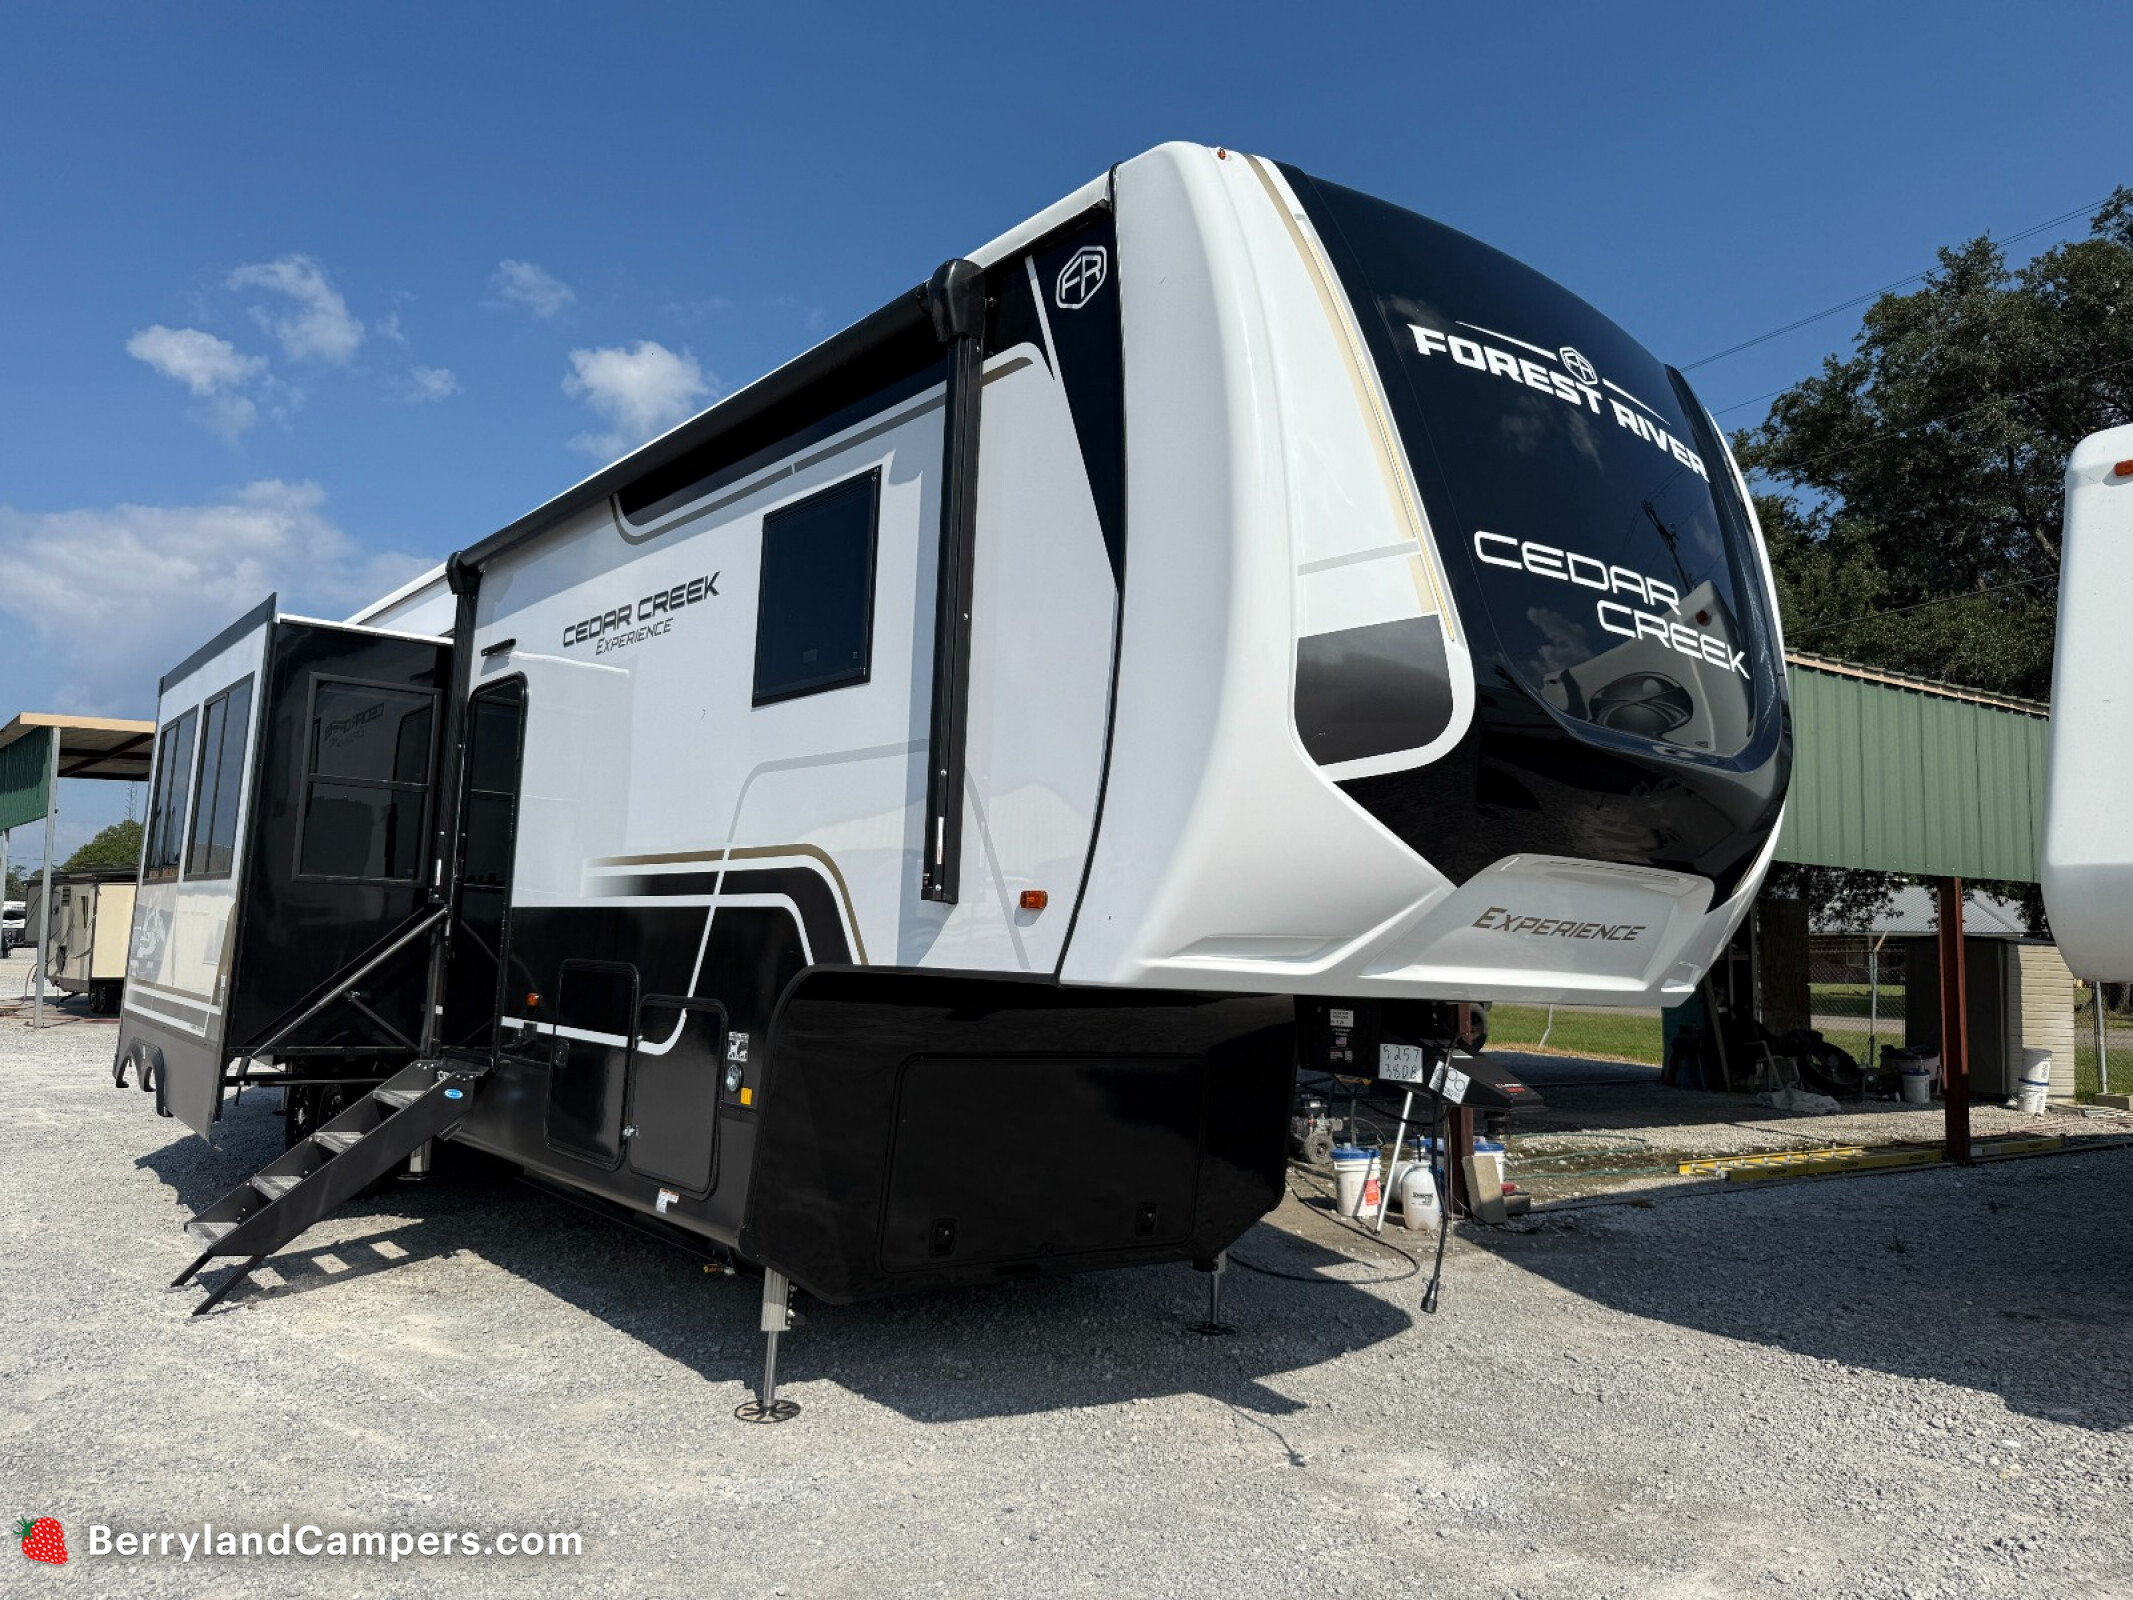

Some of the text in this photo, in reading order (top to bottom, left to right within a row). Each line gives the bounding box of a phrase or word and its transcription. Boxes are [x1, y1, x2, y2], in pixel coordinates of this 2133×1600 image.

[1408, 324, 1710, 483] FOREST RIVER
[563, 571, 721, 648] CEDAR CREEK
[1474, 530, 1681, 614] CEDAR
[595, 617, 674, 656] EXPERIENCE
[1597, 600, 1750, 680] CREEK
[1471, 906, 1647, 941] EXPERIENCE
[1383, 1045, 1420, 1062] 5257
